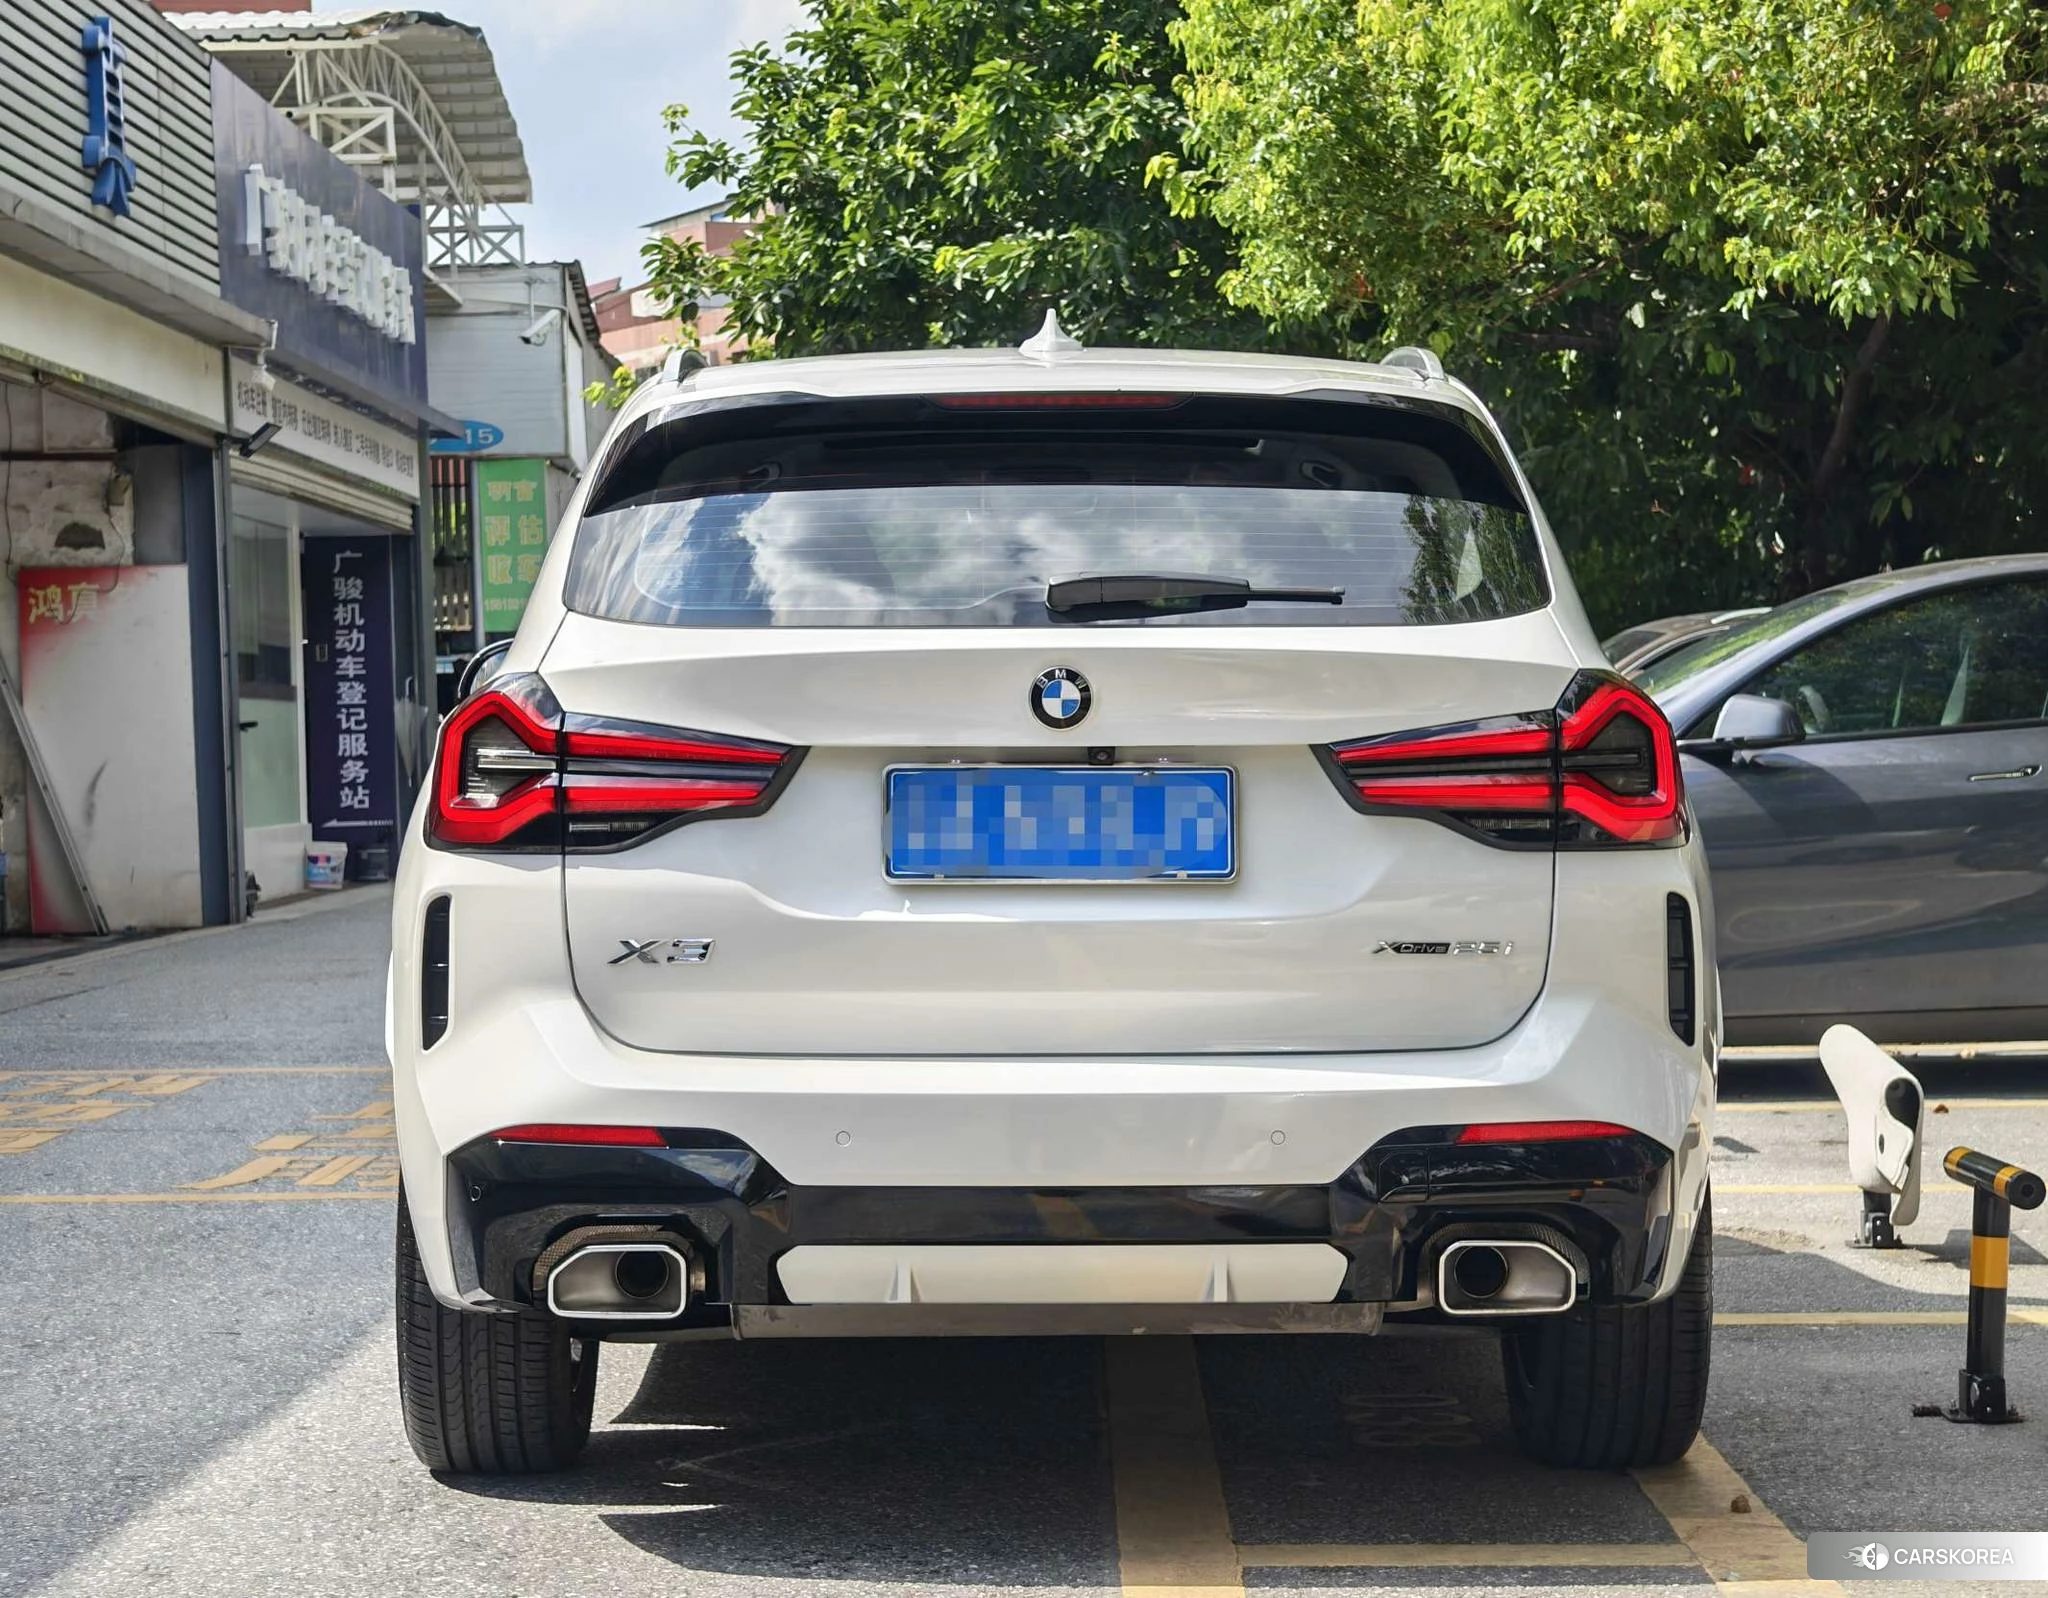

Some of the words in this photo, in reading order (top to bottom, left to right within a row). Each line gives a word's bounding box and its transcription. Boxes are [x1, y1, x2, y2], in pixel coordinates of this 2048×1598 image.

[465, 428, 494, 444] 15
[334, 551, 370, 809] 广骏机动车登记服务站
[1036, 668, 1087, 689] BMW
[607, 938, 716, 964] X3
